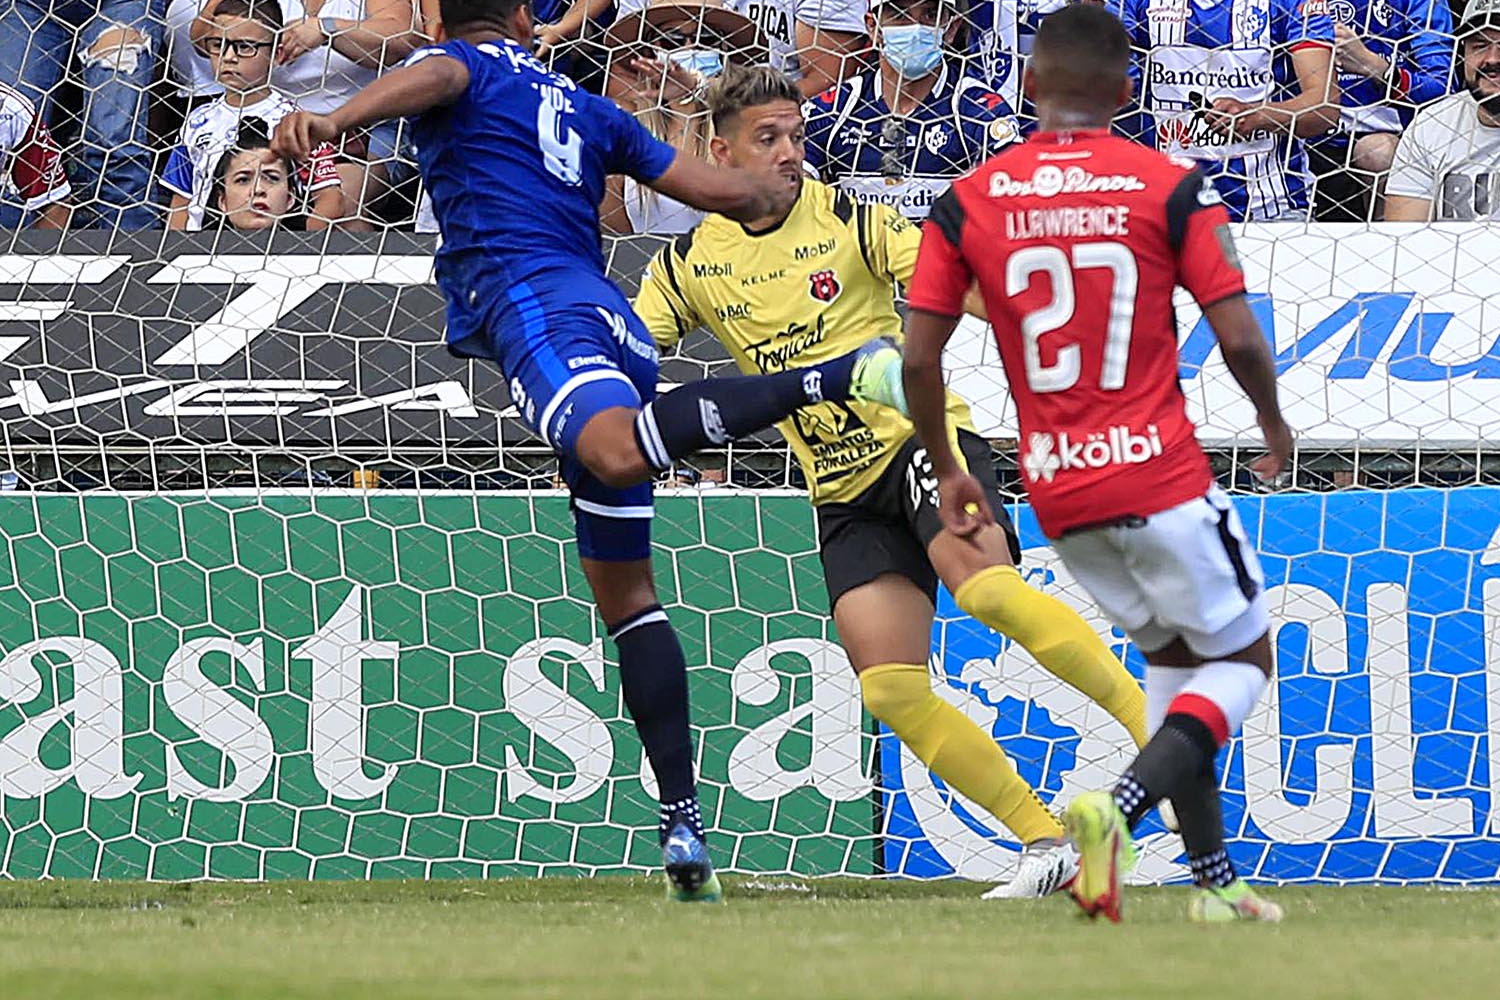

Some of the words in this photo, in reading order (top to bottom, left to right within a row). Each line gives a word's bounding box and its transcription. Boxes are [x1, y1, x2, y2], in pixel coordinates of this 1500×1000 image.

[1151, 62, 1274, 89] Bancrédito
[794, 238, 836, 261] Mobil
[693, 262, 733, 279] Mobil
[741, 268, 787, 287] KELME
[1006, 241, 1140, 394] 27
[1059, 424, 1165, 469] kölbi
